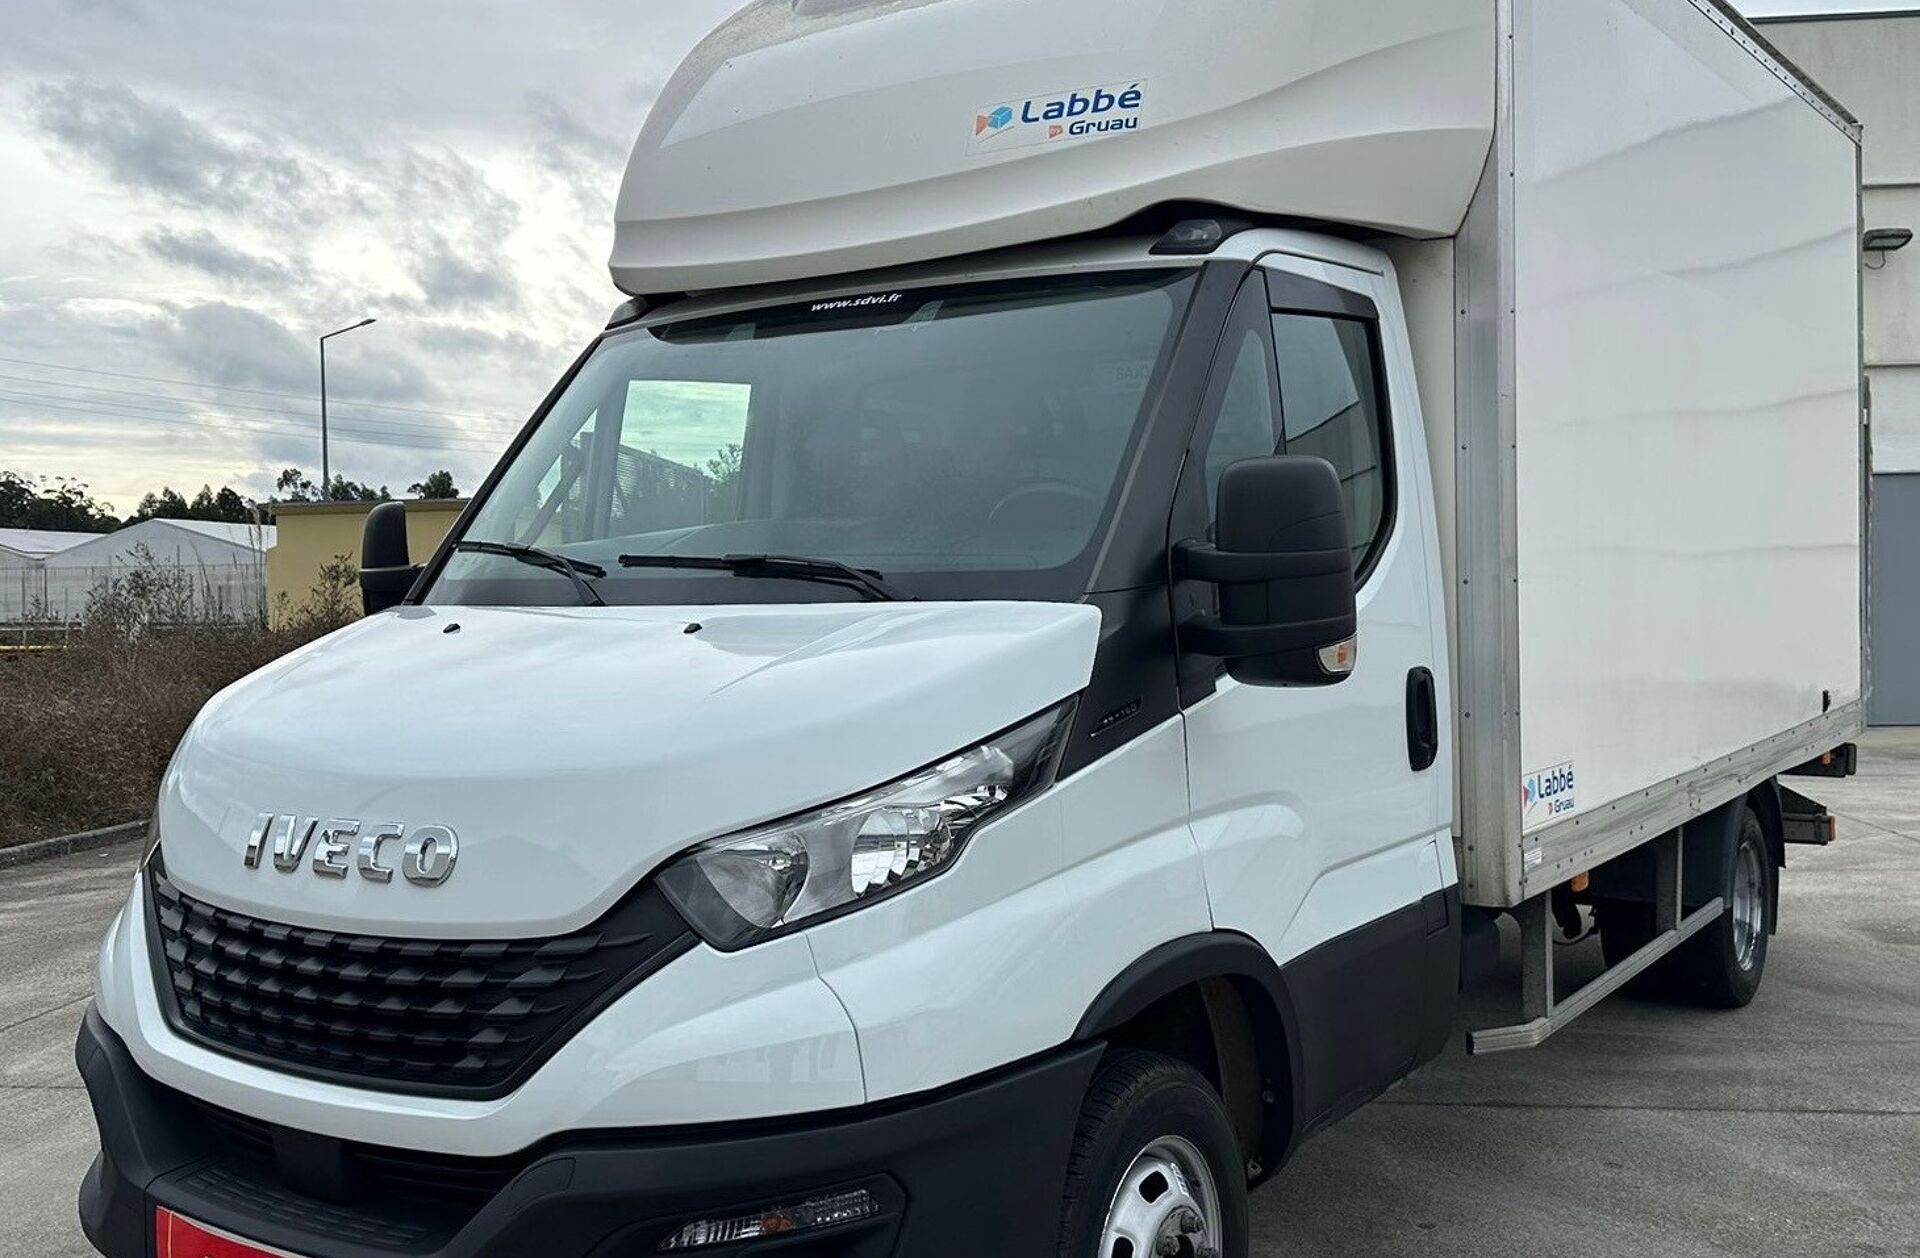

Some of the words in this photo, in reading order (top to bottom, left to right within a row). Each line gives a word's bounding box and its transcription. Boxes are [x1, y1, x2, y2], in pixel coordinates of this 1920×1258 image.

[1021, 83, 1141, 124] Labbé
[1069, 117, 1138, 135] Gruau
[811, 293, 902, 312] www.sdvi.fr
[1537, 764, 1574, 799] Labbé
[243, 811, 459, 888] IVECO
